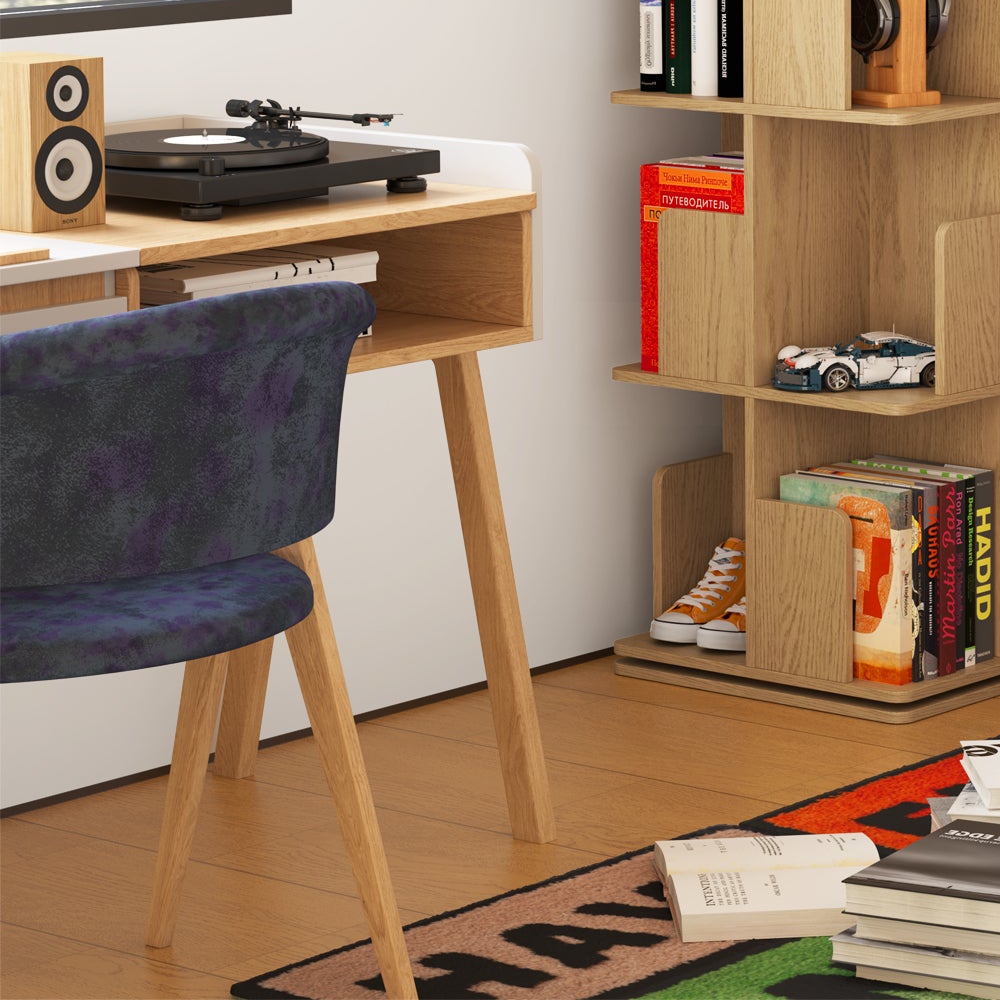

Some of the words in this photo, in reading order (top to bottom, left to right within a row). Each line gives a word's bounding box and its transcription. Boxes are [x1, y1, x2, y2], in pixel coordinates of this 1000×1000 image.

[662, 194, 730, 210] ПУТЕВОДИТЕЛЬ
[927, 505, 938, 579] BAUHAUS
[942, 487, 956, 549] Parr
[942, 553, 956, 639] Martin
[976, 506, 991, 621] HADID
